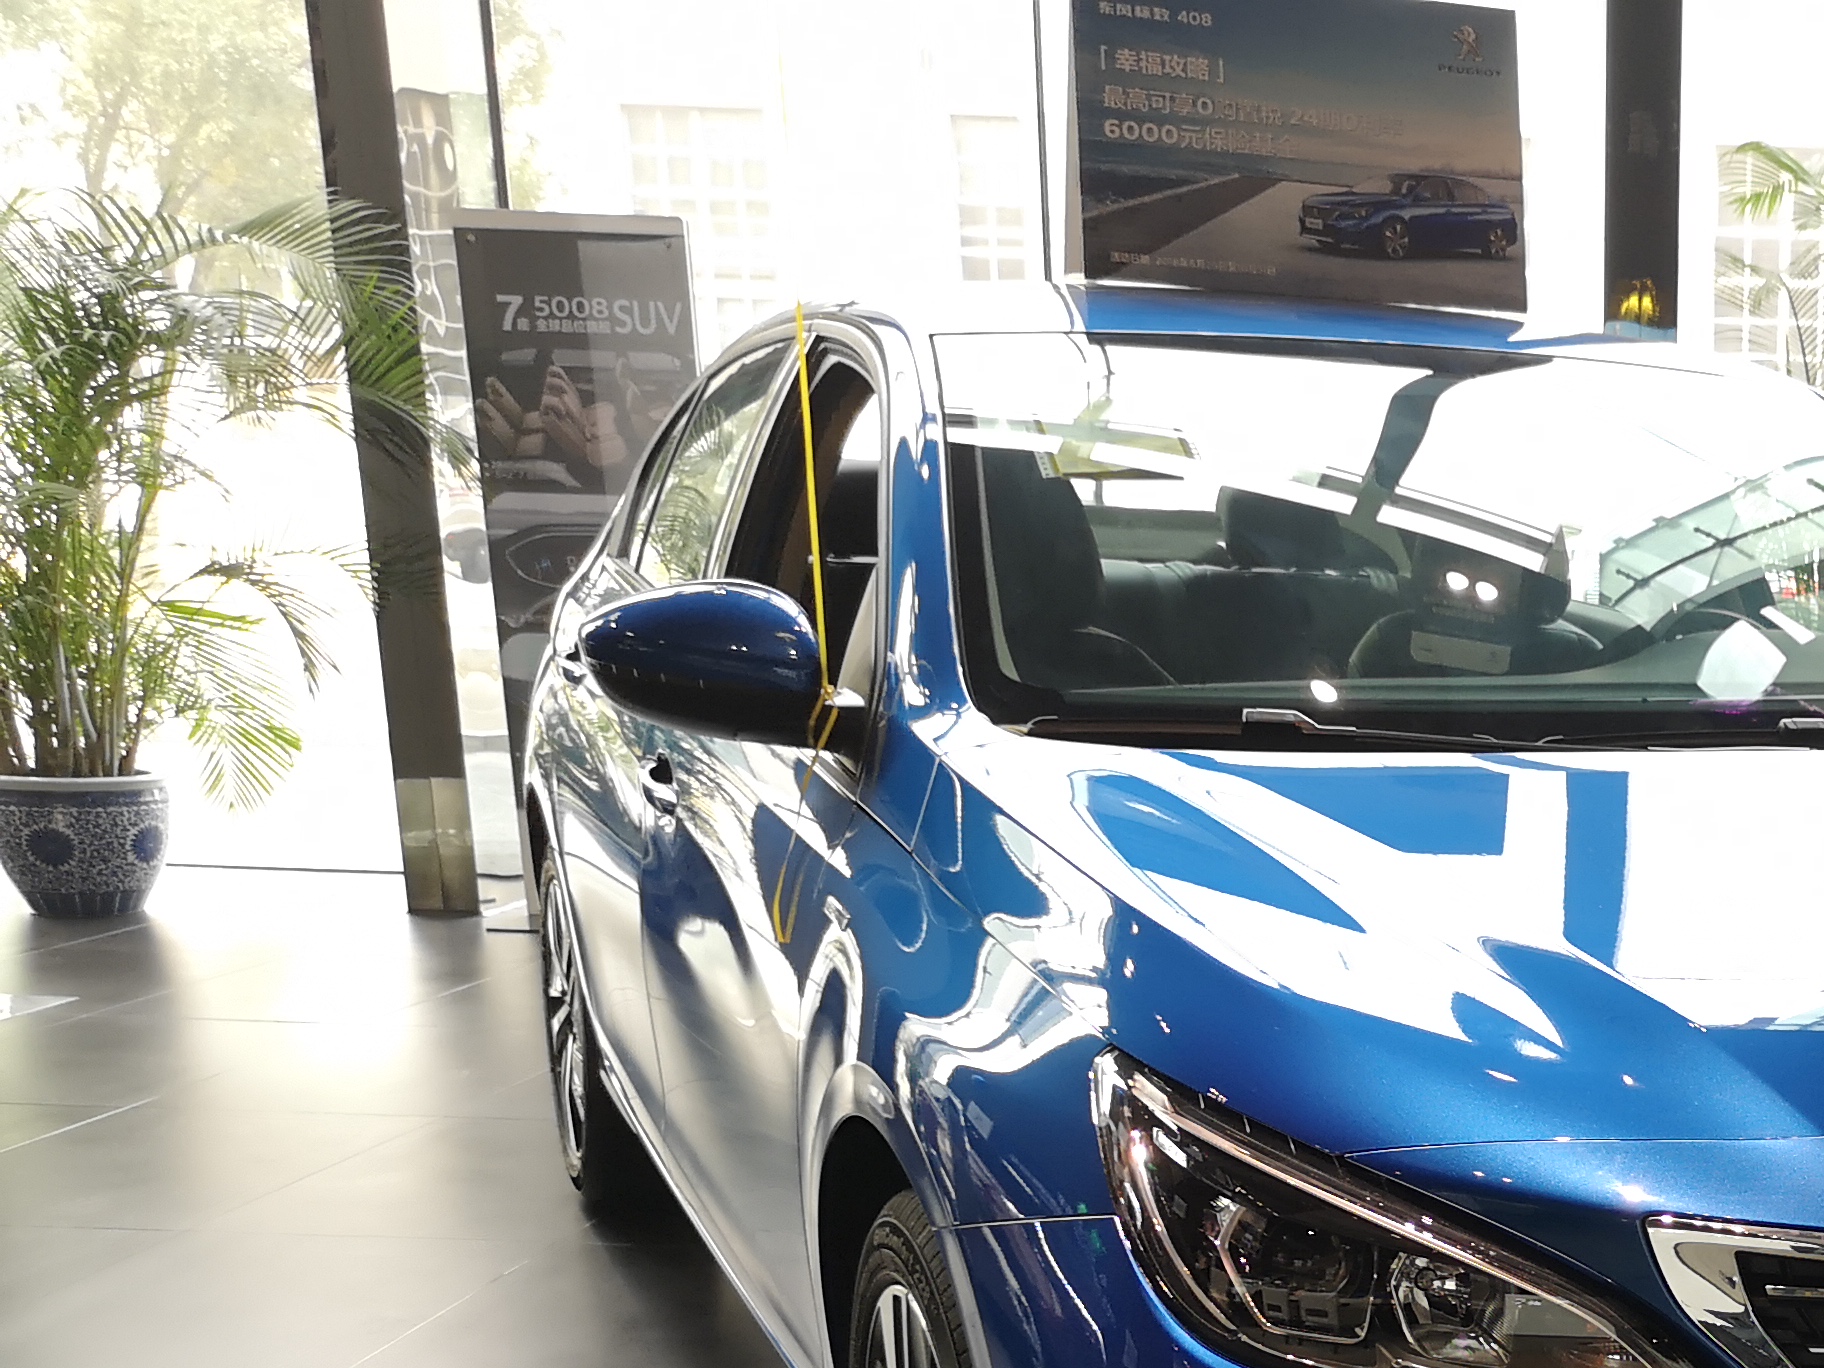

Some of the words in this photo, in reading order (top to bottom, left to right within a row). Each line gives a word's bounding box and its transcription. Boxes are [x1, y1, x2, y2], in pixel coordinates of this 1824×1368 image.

[1177, 10, 1213, 27] 408
[534, 295, 610, 318] 5008
[613, 300, 682, 335] SUV
